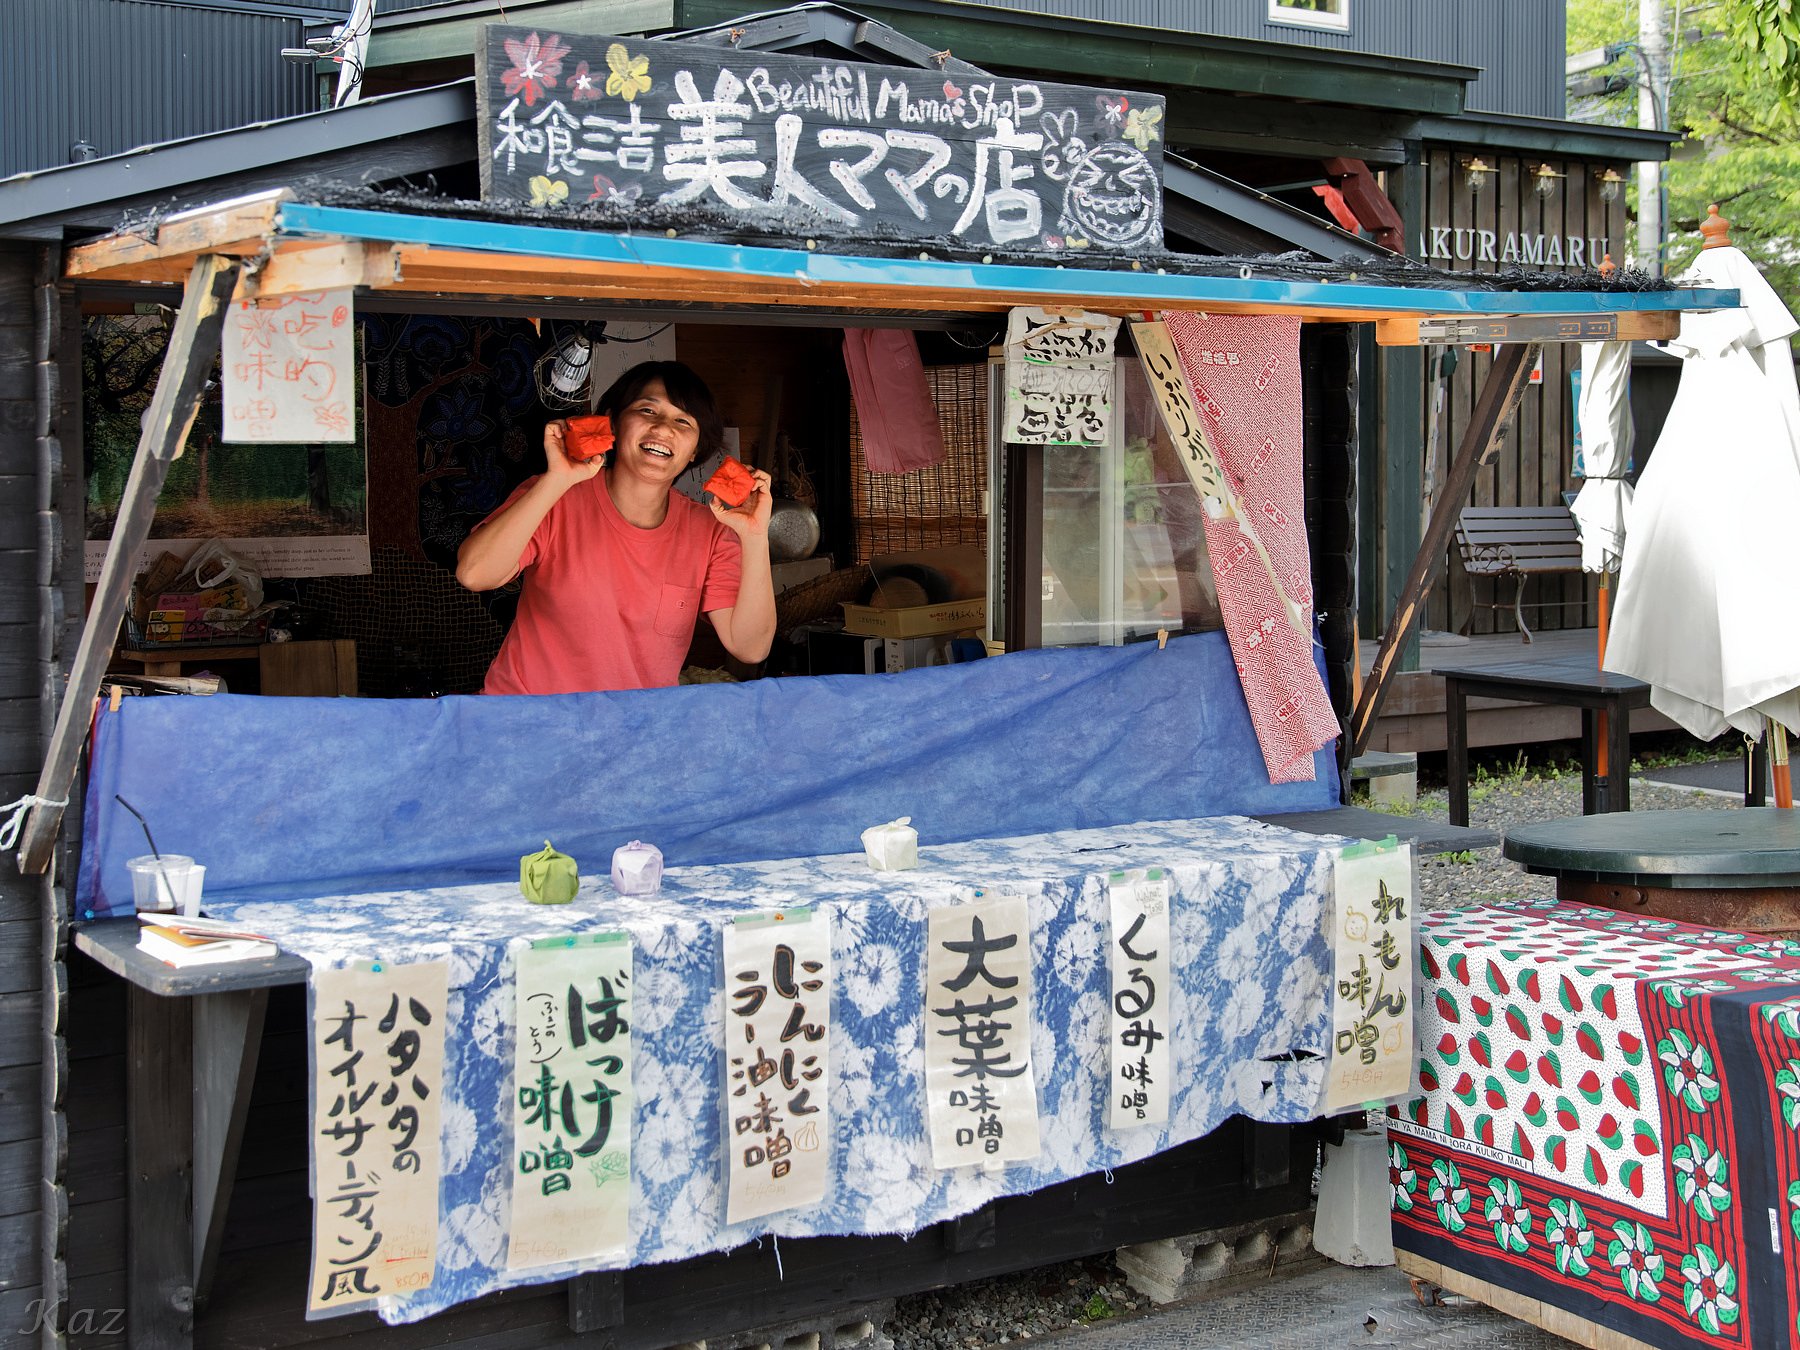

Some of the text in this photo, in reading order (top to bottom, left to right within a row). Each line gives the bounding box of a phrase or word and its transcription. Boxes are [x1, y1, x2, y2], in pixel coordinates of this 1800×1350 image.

[493, 98, 662, 176] 和食三吉
[659, 68, 1044, 243] 美人ママの店
[746, 65, 871, 124] Beautiful
[773, 943, 826, 1117] にんにく
[932, 914, 1029, 1155] 大葉味噌
[1114, 912, 1165, 1120] くるみ味噌
[1336, 953, 1380, 1066] 味噌
[1365, 878, 1408, 1021] れもん
[319, 999, 382, 1301] オイルサーディン風
[377, 992, 433, 1175] ハタハタの
[519, 1062, 574, 1197] 味噌
[560, 969, 630, 1158] ばっけ
[731, 969, 793, 1179] ラー油味噌
[1402, 1122, 1412, 1133] YA
[1414, 1126, 1438, 1141] MAMA
[1475, 1145, 1504, 1161] KULIKO
[1507, 1155, 1528, 1169] MALI
